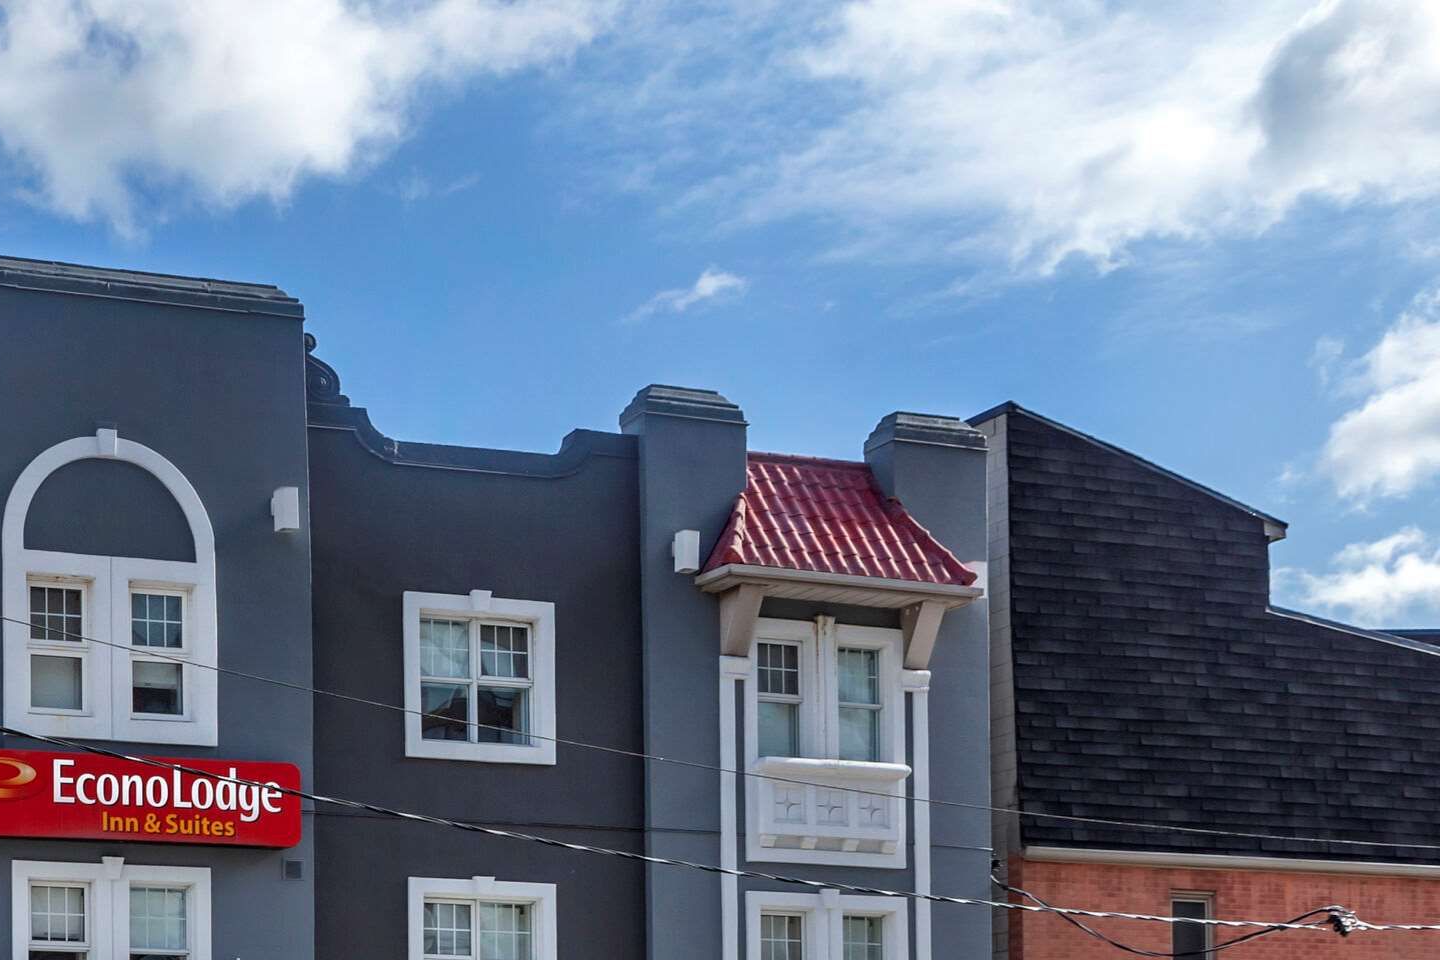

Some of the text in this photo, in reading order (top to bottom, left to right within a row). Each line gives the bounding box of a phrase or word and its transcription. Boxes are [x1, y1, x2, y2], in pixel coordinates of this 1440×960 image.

[101, 811, 236, 837] Inn & Suites
